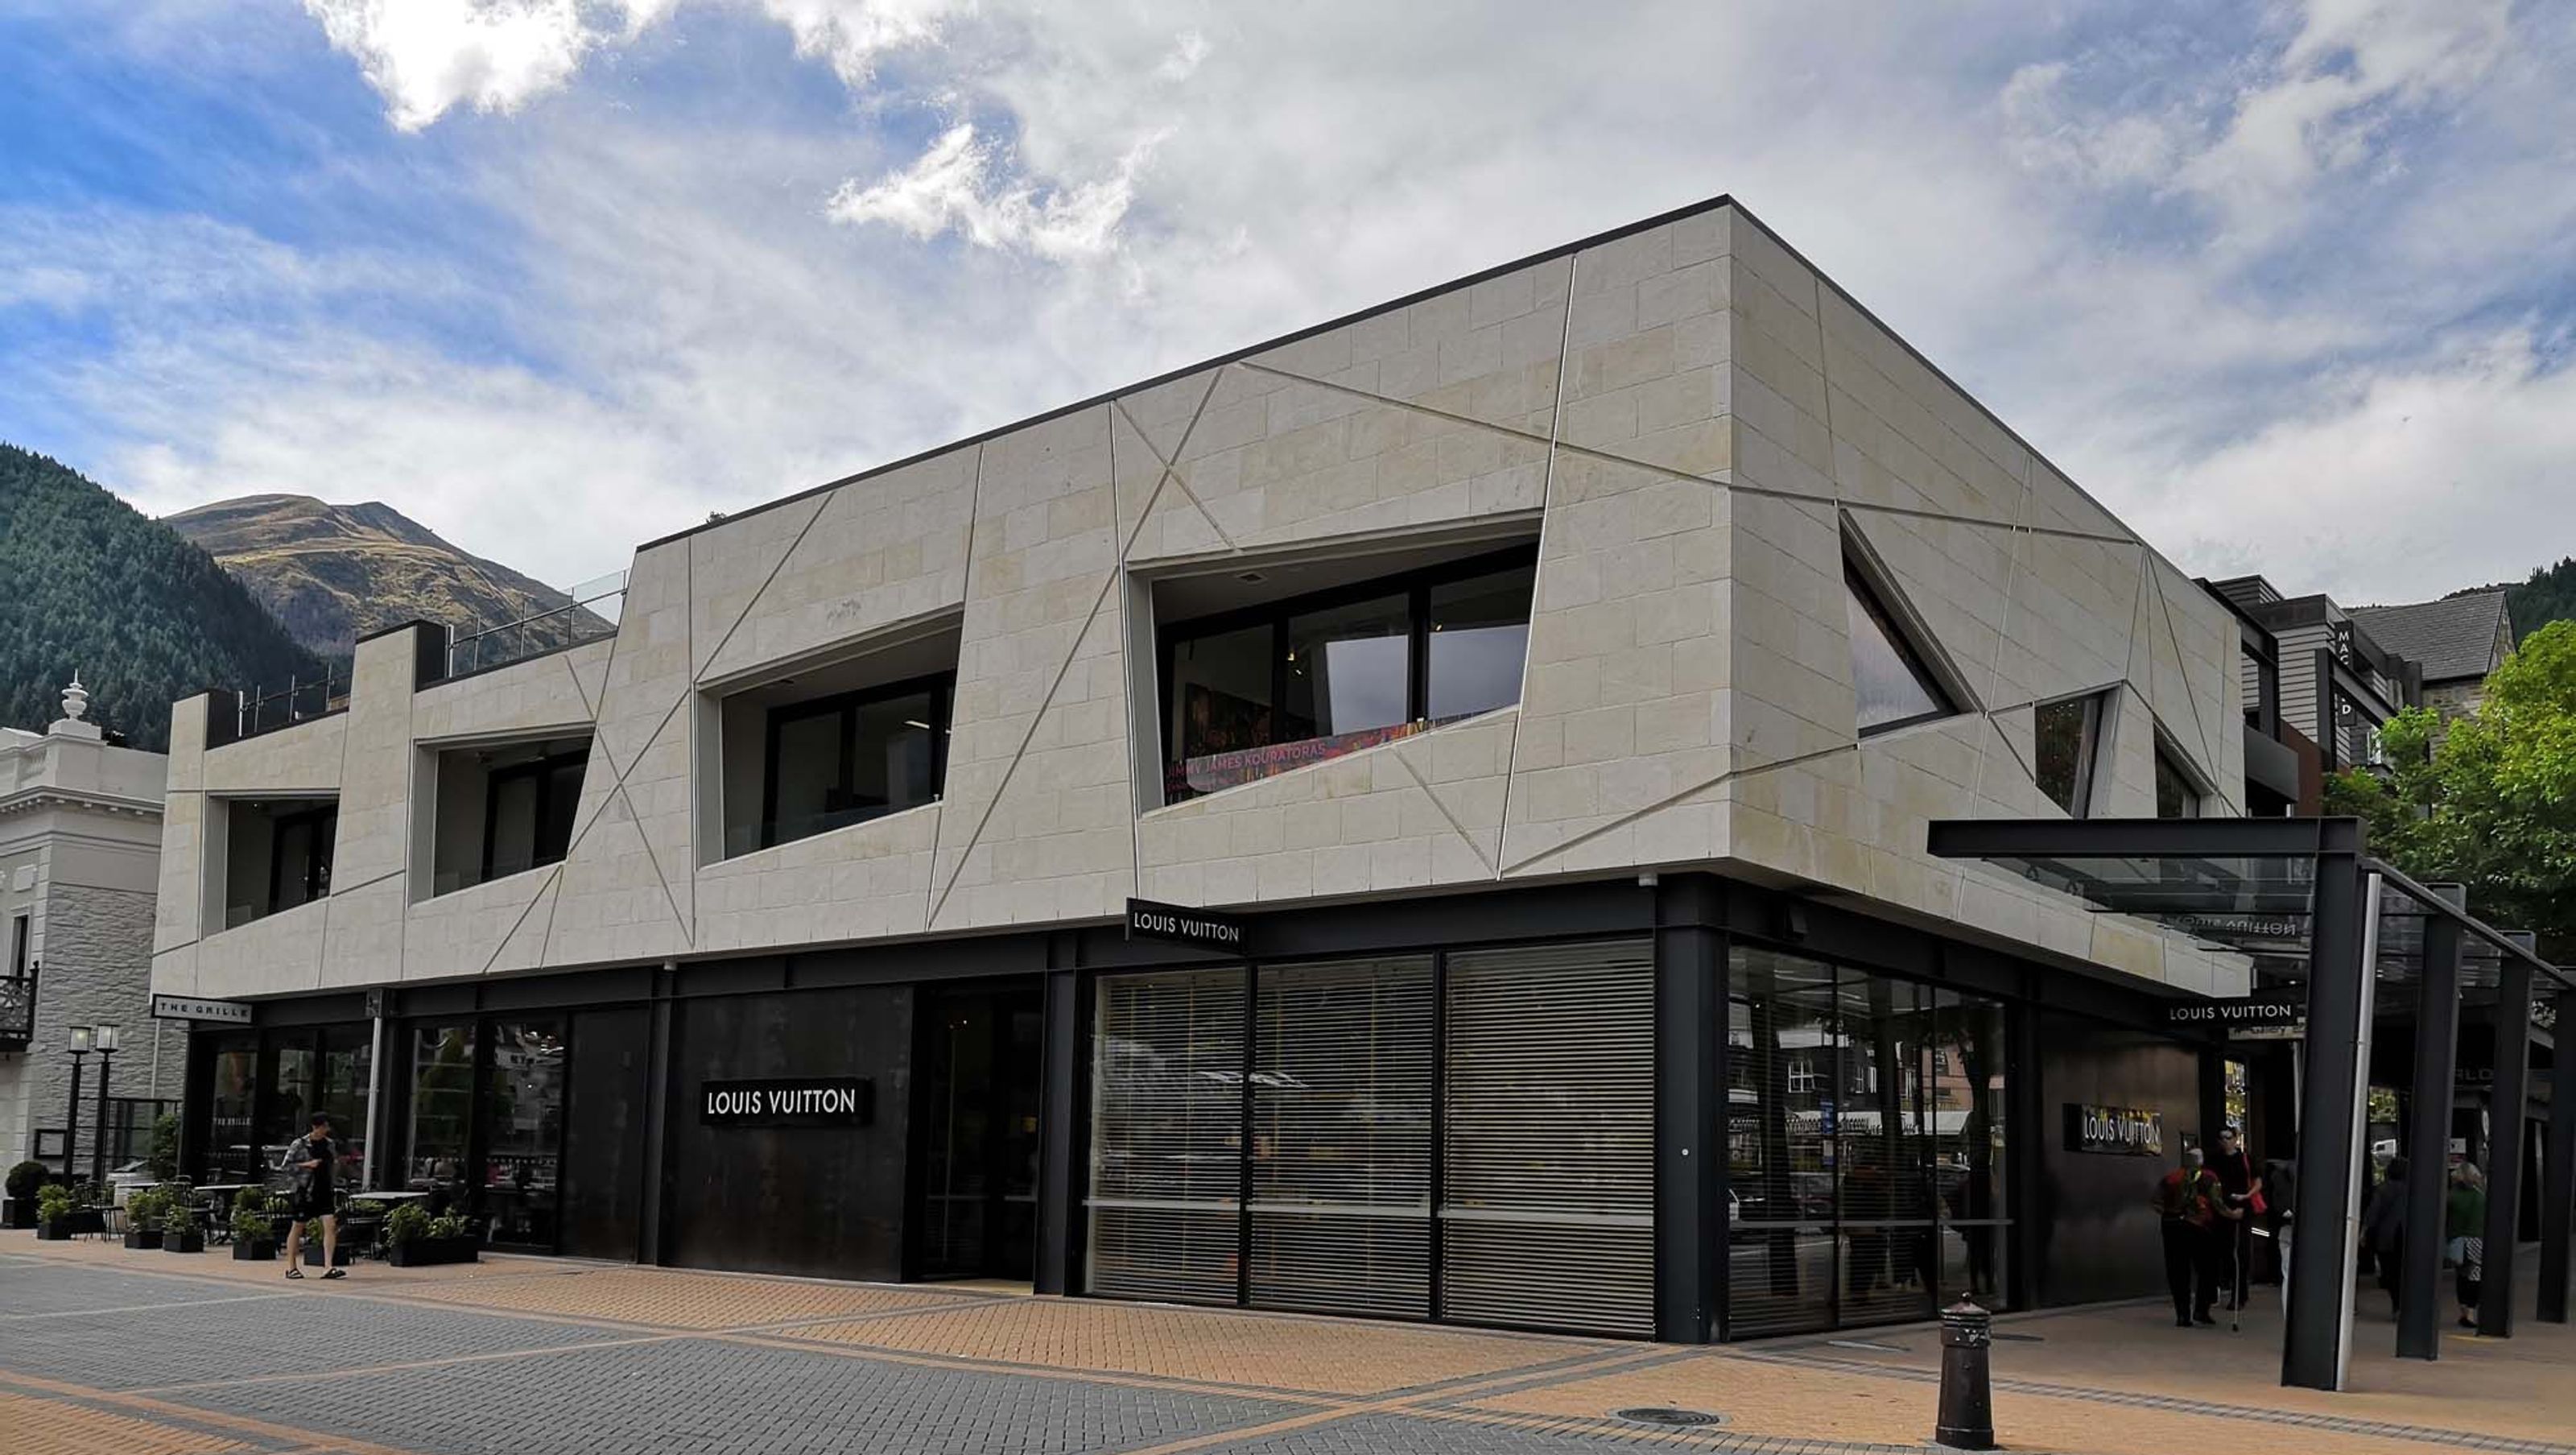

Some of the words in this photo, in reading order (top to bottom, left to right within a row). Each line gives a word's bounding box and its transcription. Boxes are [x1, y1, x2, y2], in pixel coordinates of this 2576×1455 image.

[1206, 755, 1244, 773] JAMES
[1245, 743, 1327, 767] KOURATORAS
[1133, 911, 1175, 933] LOUIS
[1181, 919, 1239, 942] VUITTON
[161, 1003, 188, 1013] THE
[196, 1006, 248, 1018] GRILLE
[2169, 1007, 2215, 1020] LOUIS
[2220, 1005, 2291, 1019] VUITTON
[708, 1090, 762, 1114] LOUIS
[768, 1089, 856, 1114] VUITTON
[2083, 1114, 2115, 1142] LOUIS
[2117, 1115, 2161, 1147] VUITTON
